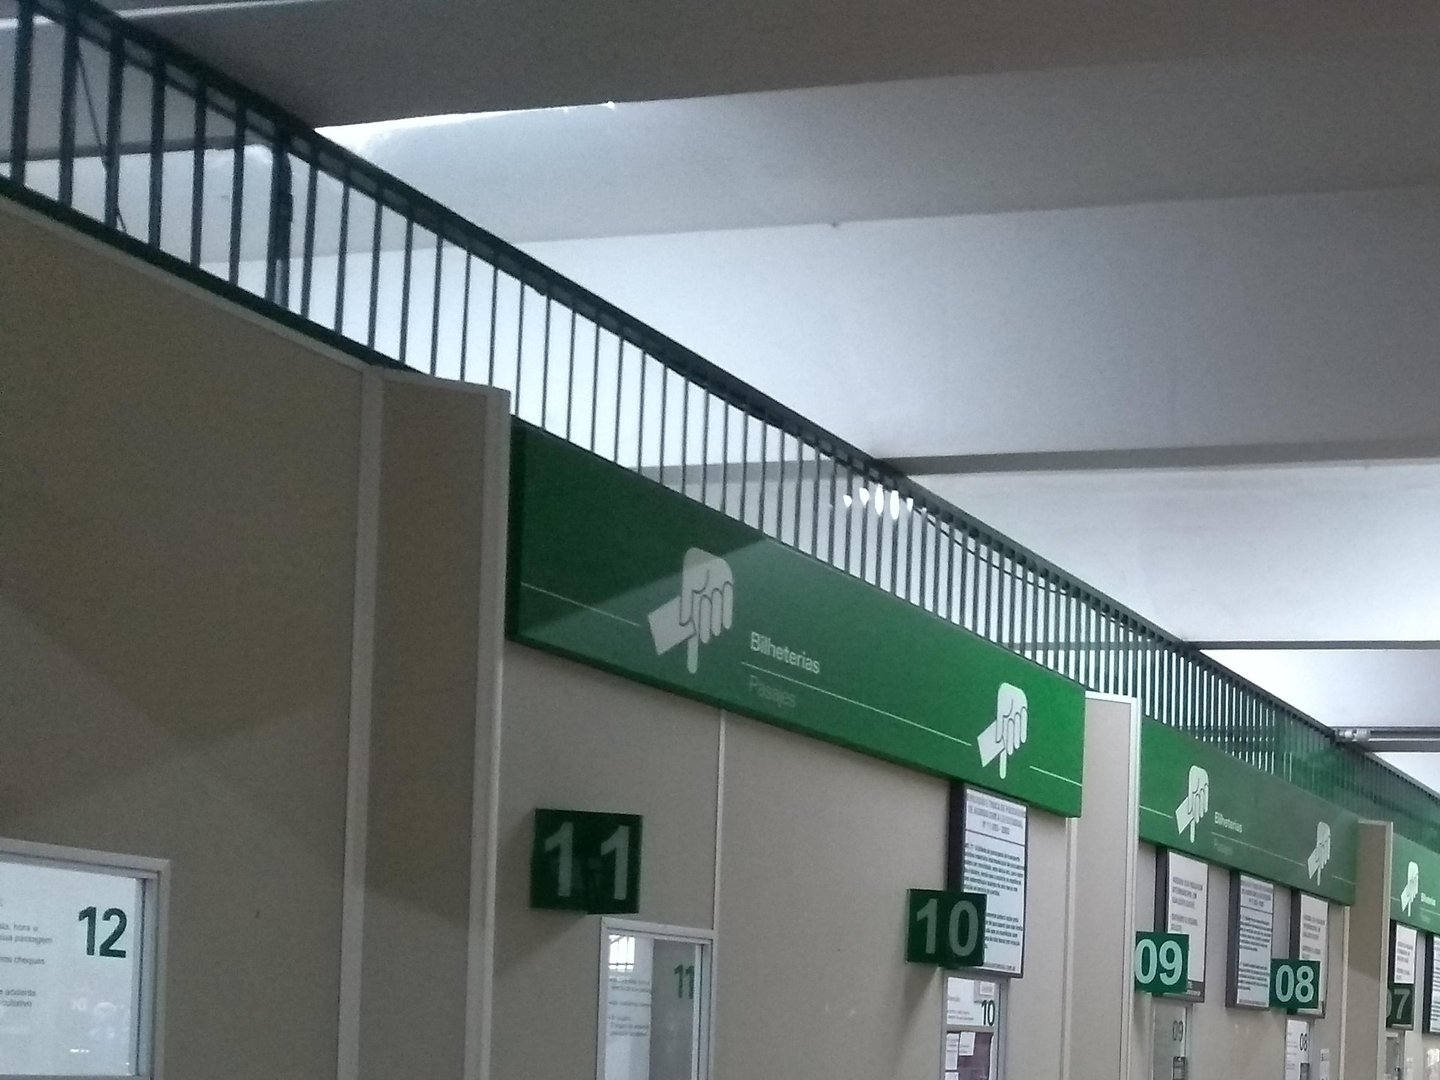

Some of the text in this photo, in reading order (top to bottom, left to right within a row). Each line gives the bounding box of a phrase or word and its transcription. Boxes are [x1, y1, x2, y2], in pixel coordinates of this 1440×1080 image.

[750, 631, 820, 674] Bilheterias
[544, 822, 629, 900] 11
[78, 906, 127, 958] 12
[917, 898, 979, 957] 10
[674, 964, 695, 999] 11
[1135, 938, 1182, 985] 09
[1276, 964, 1314, 1003] 08
[1386, 987, 1410, 1020] 7
[981, 999, 996, 1026] 10
